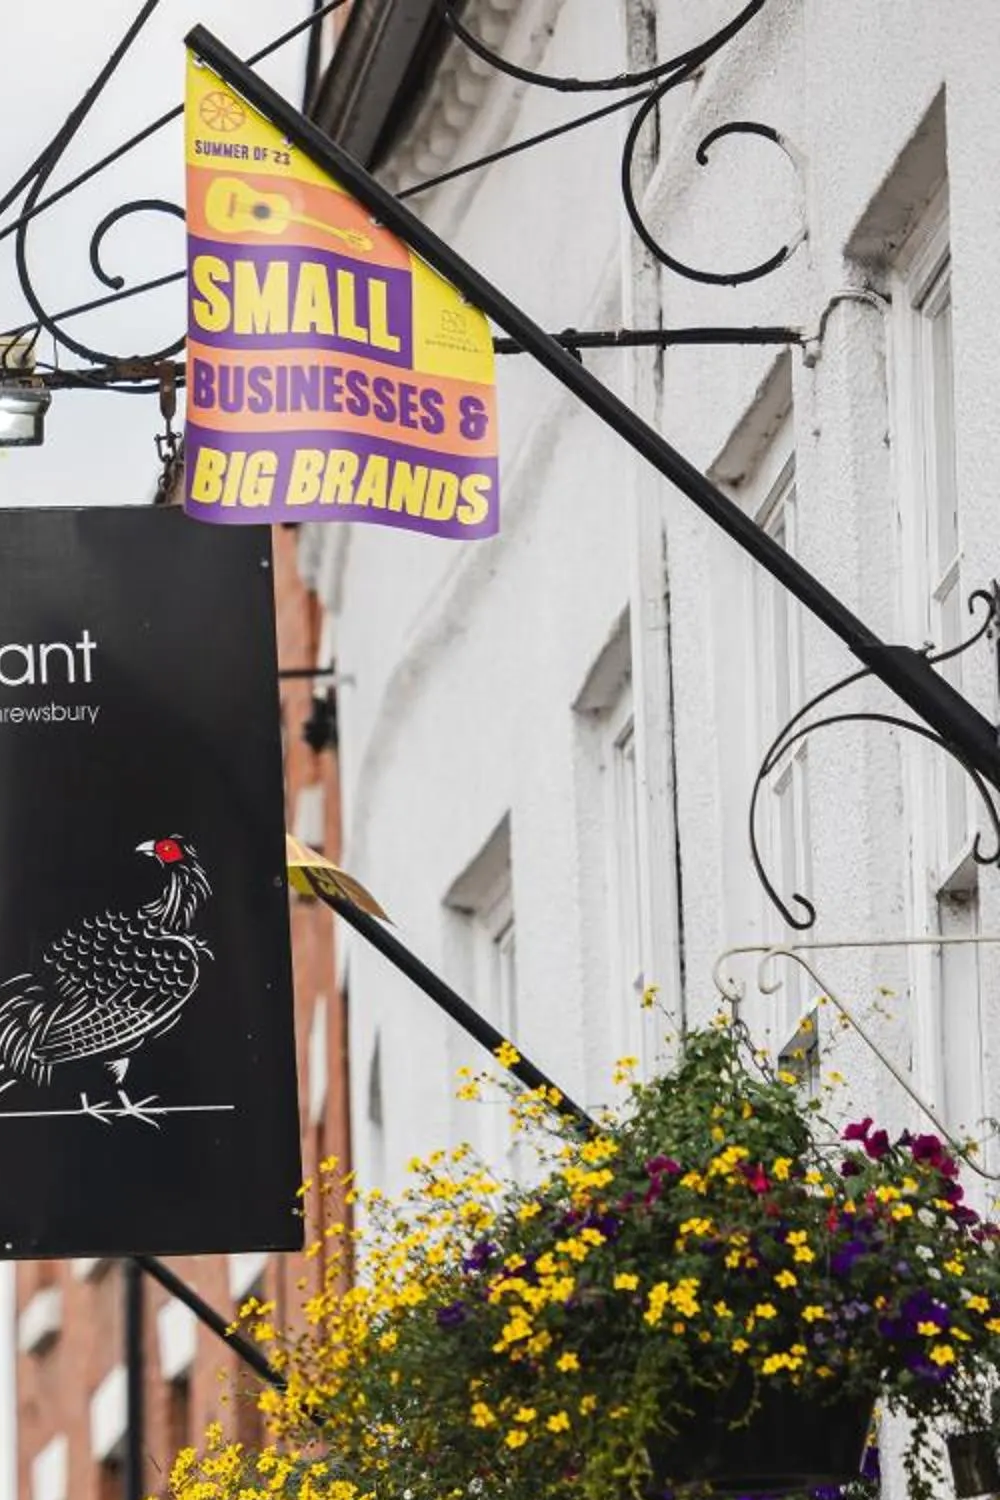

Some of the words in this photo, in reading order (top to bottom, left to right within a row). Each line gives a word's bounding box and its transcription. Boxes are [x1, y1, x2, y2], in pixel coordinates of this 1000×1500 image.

[194, 139, 249, 160] SUMMER
[253, 145, 268, 161] OF
[192, 254, 400, 353] SMALL
[193, 357, 445, 434] BUSINESSES
[459, 395, 489, 441] &
[191, 447, 277, 507] BIG
[287, 447, 492, 525] BRANDS
